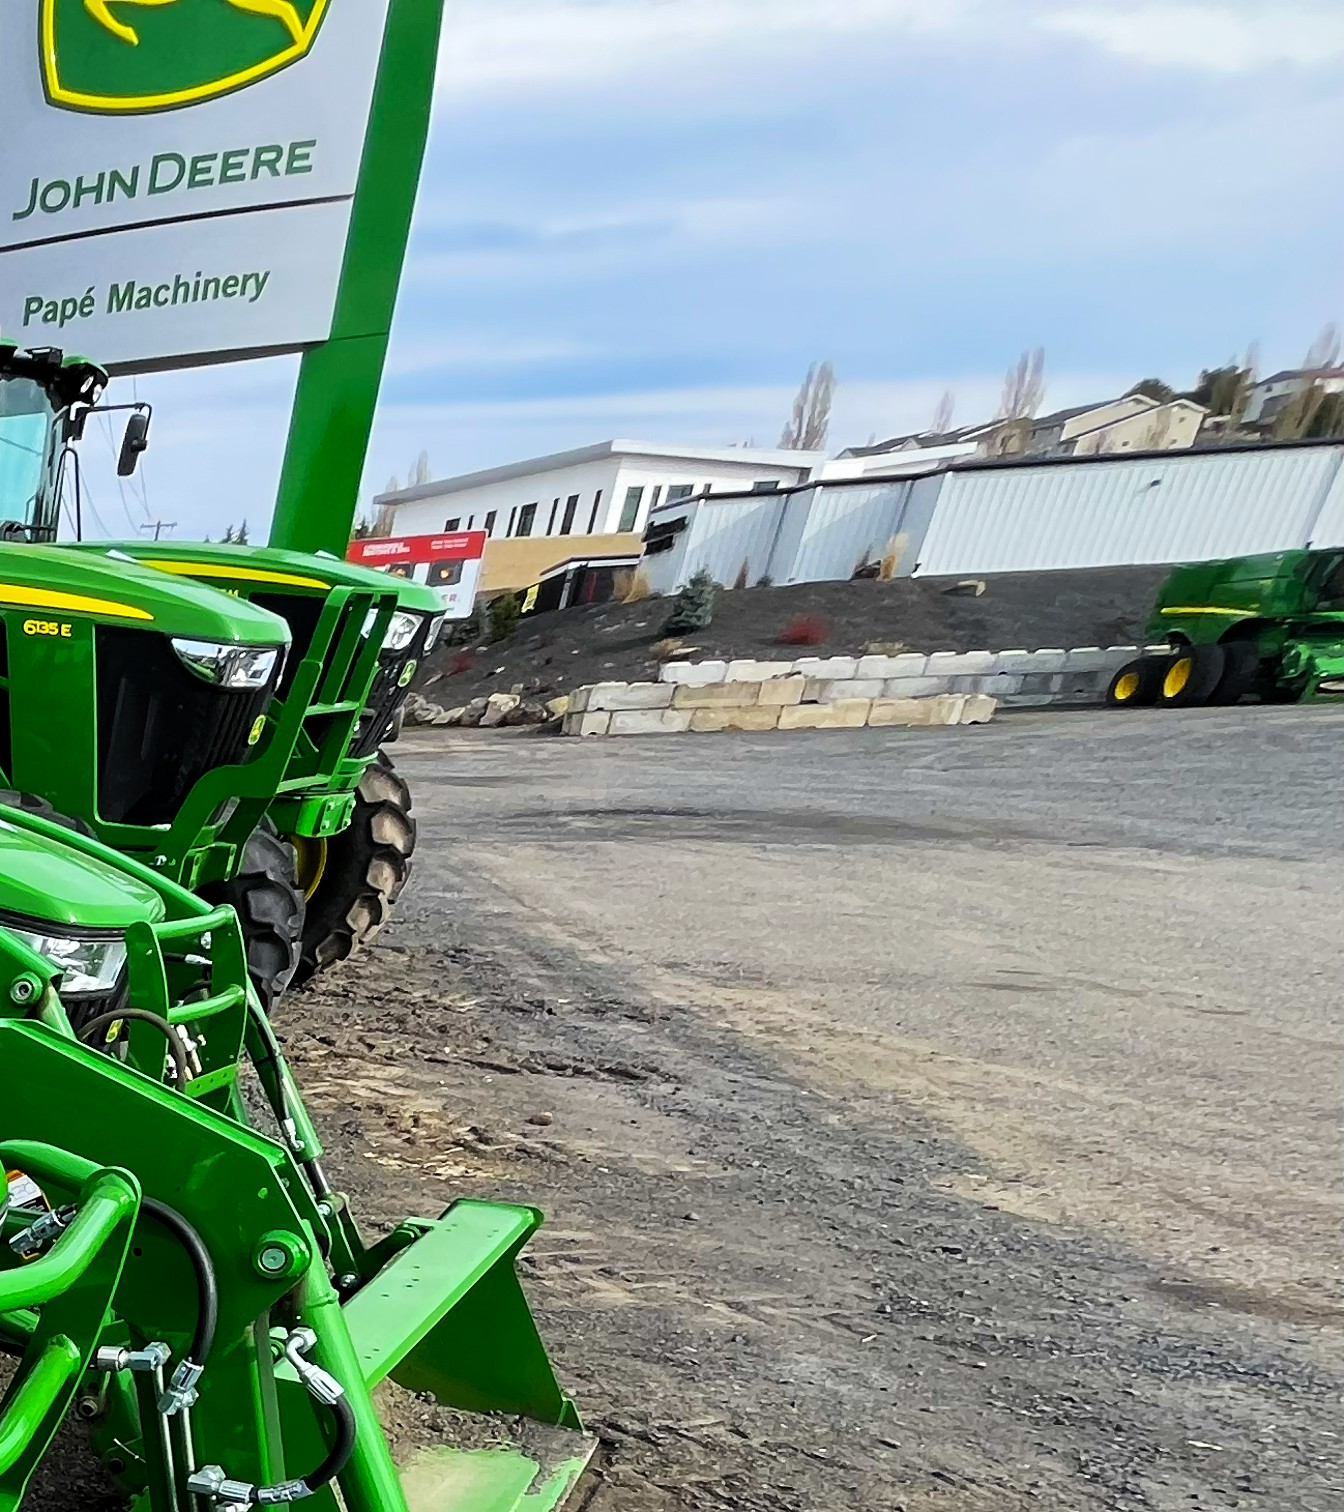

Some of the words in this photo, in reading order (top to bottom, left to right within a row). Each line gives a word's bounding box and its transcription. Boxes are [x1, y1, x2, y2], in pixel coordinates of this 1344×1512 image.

[12, 164, 140, 220] JOHN
[147, 140, 317, 196] DEERE
[22, 287, 95, 327] Papé
[106, 269, 270, 313] Machinery
[23, 619, 59, 636] 6135
[60, 622, 72, 637] E
